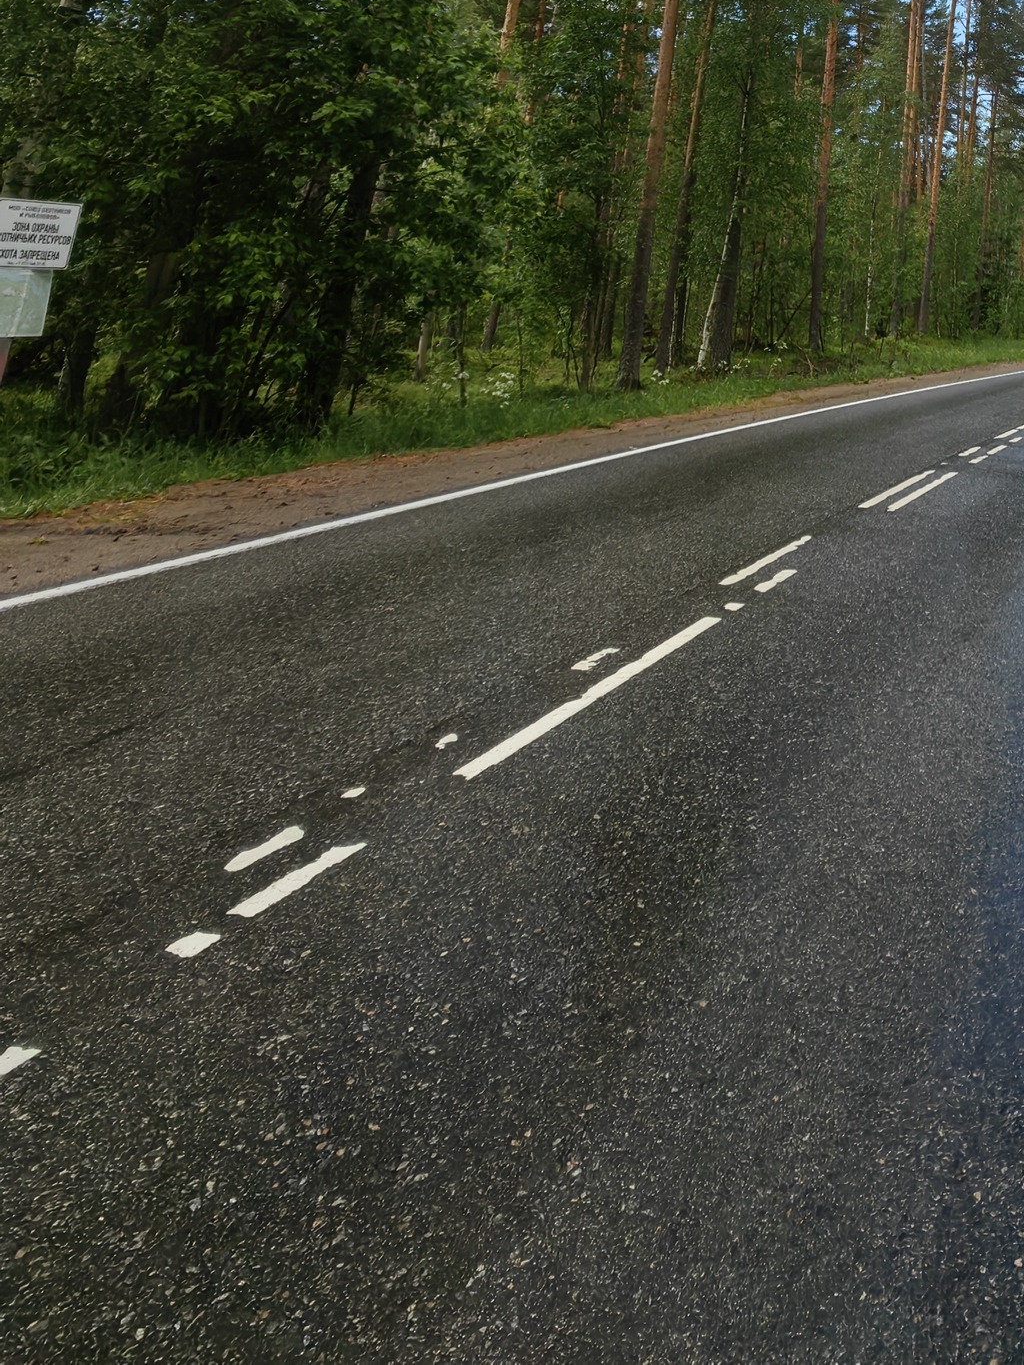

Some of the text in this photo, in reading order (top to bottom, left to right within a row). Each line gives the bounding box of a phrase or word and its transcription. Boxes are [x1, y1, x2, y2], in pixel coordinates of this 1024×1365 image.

[12, 221, 60, 234] ЗОНА ОХРАНЫ
[0, 232, 71, 245] ОТНИЧЬИХ РЕСУРСОВ
[0, 248, 60, 261] ХОТА ЗАПРЕЩЕНА
